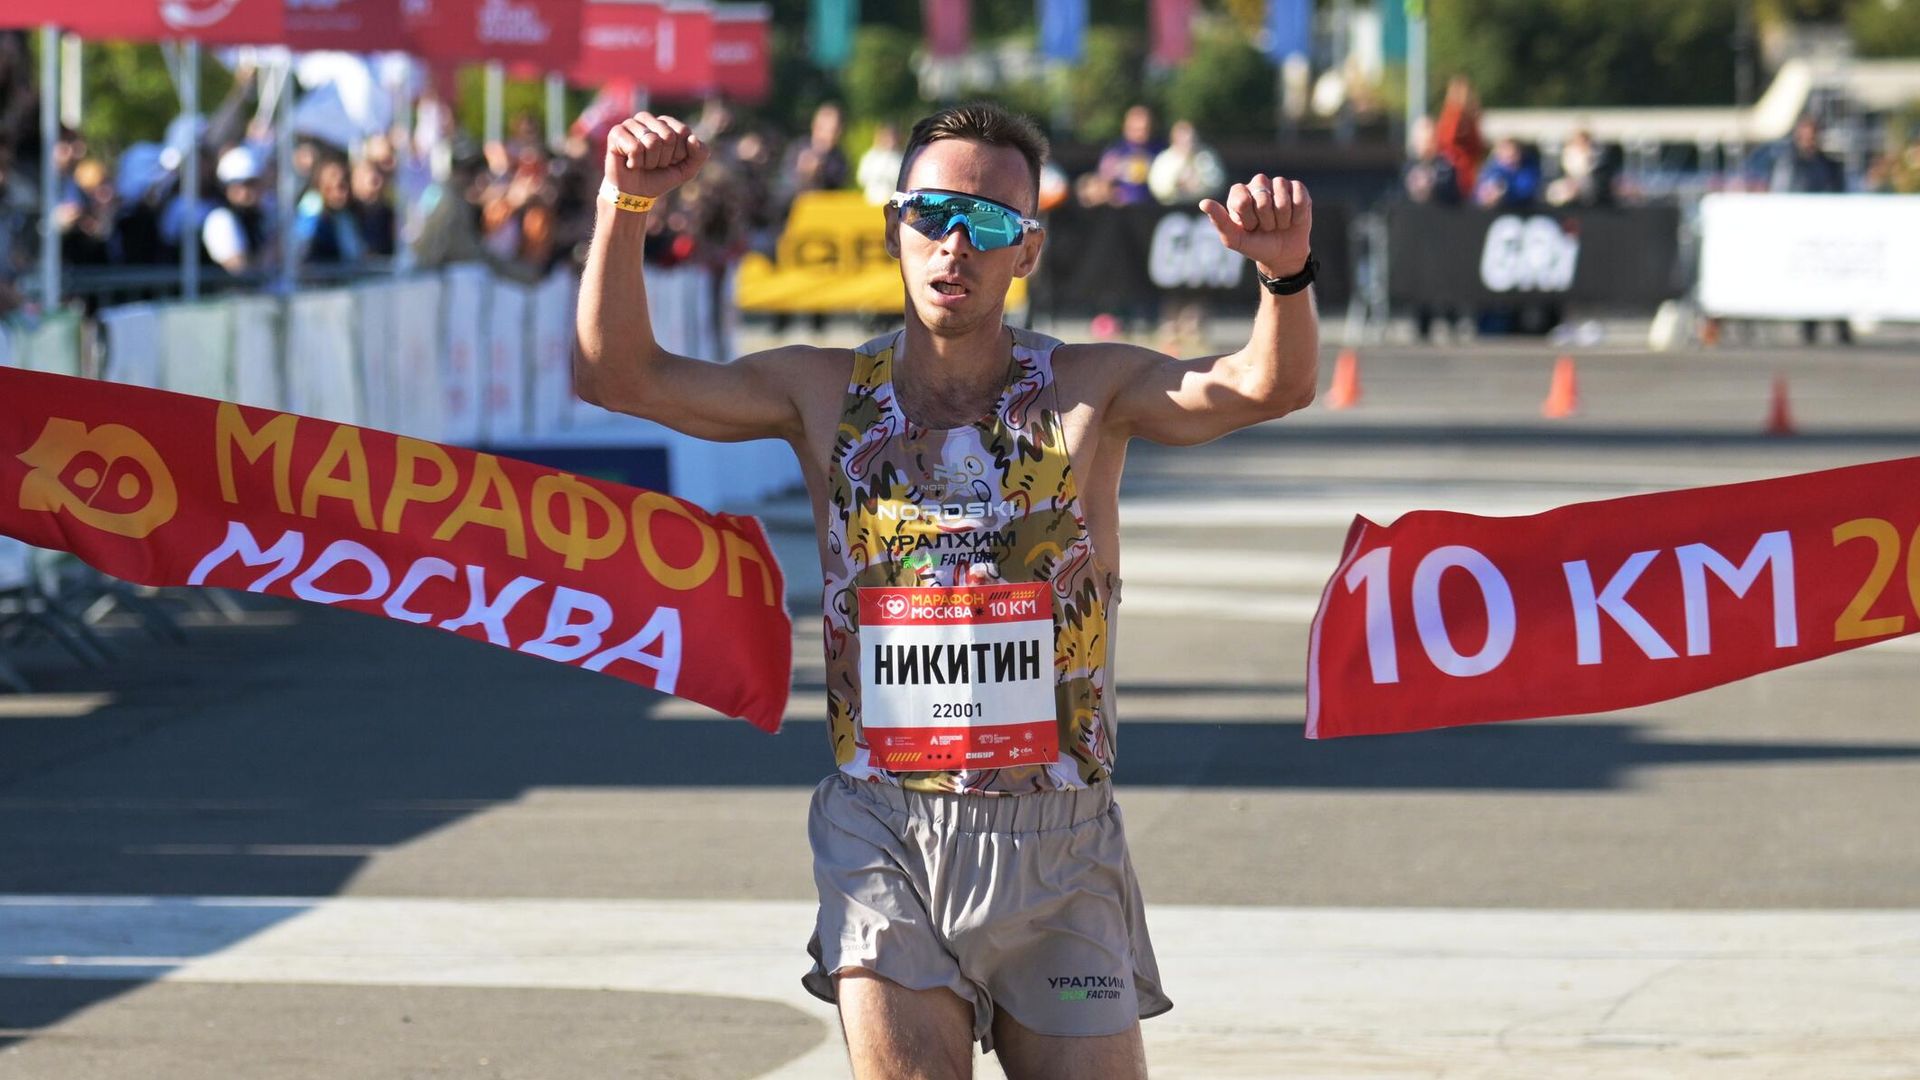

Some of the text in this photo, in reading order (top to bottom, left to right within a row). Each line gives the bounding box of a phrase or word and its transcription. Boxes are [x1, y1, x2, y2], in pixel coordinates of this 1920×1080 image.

[877, 501, 1016, 521] NORDSKI
[880, 530, 1017, 553] УРАЛХИМ
[187, 521, 683, 695] МОСКВА
[911, 593, 984, 607] МАРАФОН
[911, 606, 973, 619] МОСКВА
[989, 602, 1007, 617] 10
[1345, 545, 1517, 684] 10
[875, 640, 1040, 685] НИКИТИН
[933, 703, 982, 718] 22001
[1047, 976, 1125, 989] УРАЛХИМ
